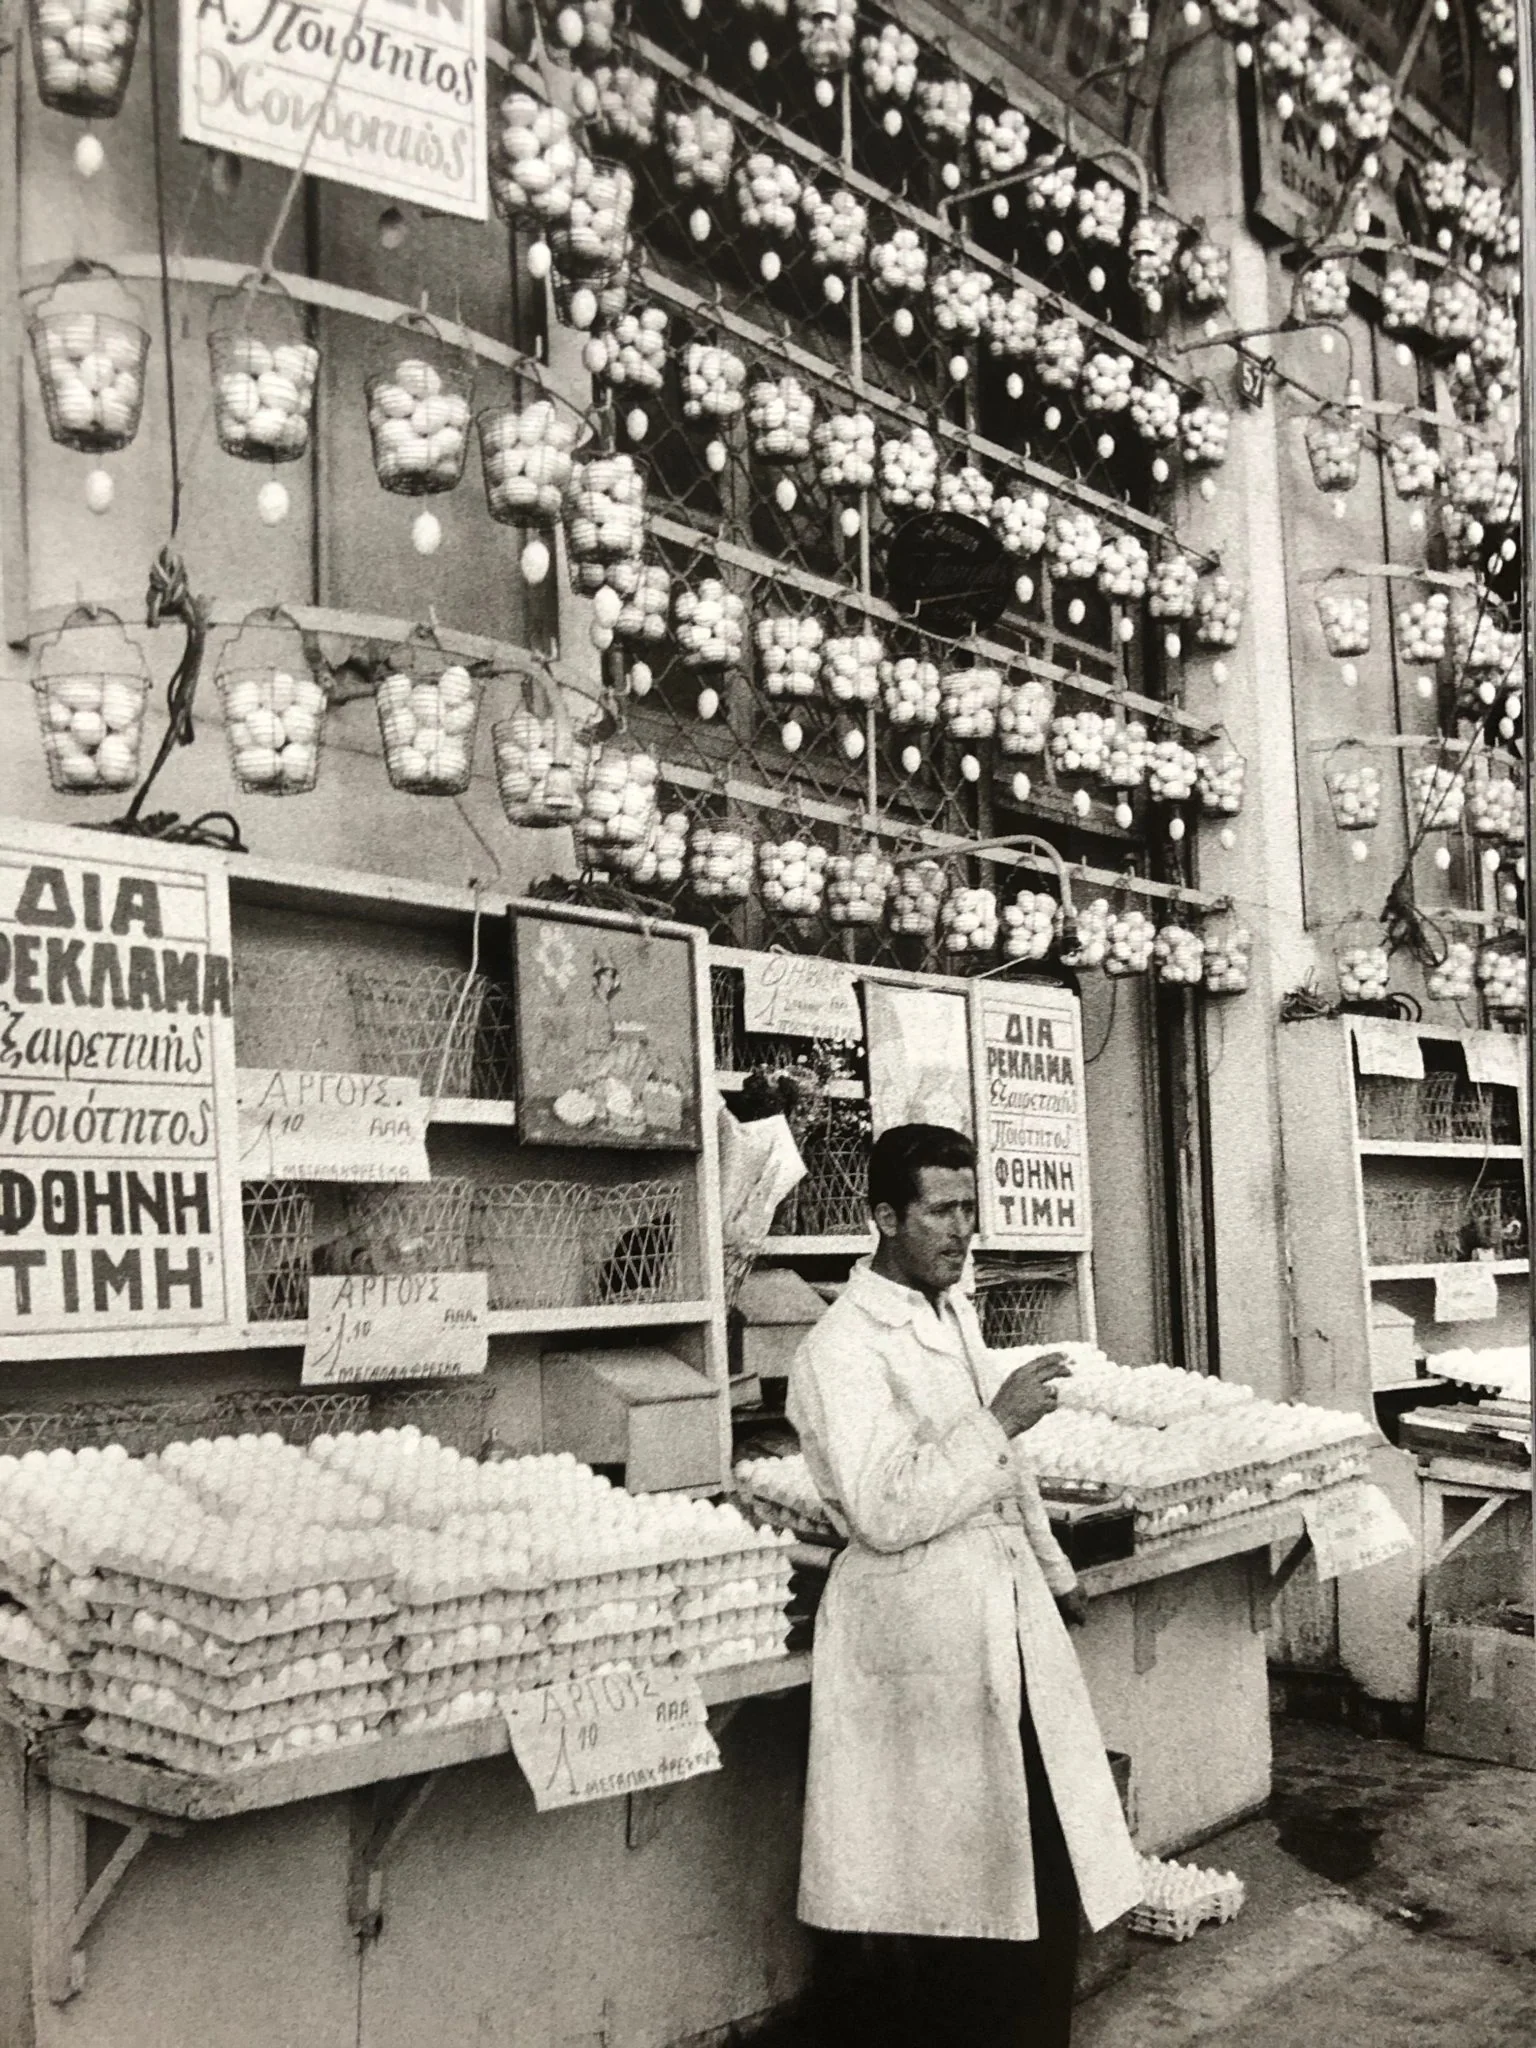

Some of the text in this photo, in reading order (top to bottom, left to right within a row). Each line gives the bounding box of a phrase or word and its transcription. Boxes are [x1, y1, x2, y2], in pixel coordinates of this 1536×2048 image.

[15, 866, 164, 939] ΔΙΑ
[1005, 1013, 1054, 1049] ΔΙΑ
[987, 1046, 1074, 1086] ΡΕΚΛΑΜΑ
[994, 1156, 1075, 1192] ΦΘΗΝΗ
[0, 1168, 211, 1237] ΦΘΗΝΗ
[998, 1195, 1076, 1228] ΤΙΜΗ
[0, 1247, 203, 1315] ΤΙΜΗ
[331, 1275, 440, 1311] ΑΡΓΟΥΣ
[540, 1671, 660, 1725] ΑΡΓΟΥΣ
